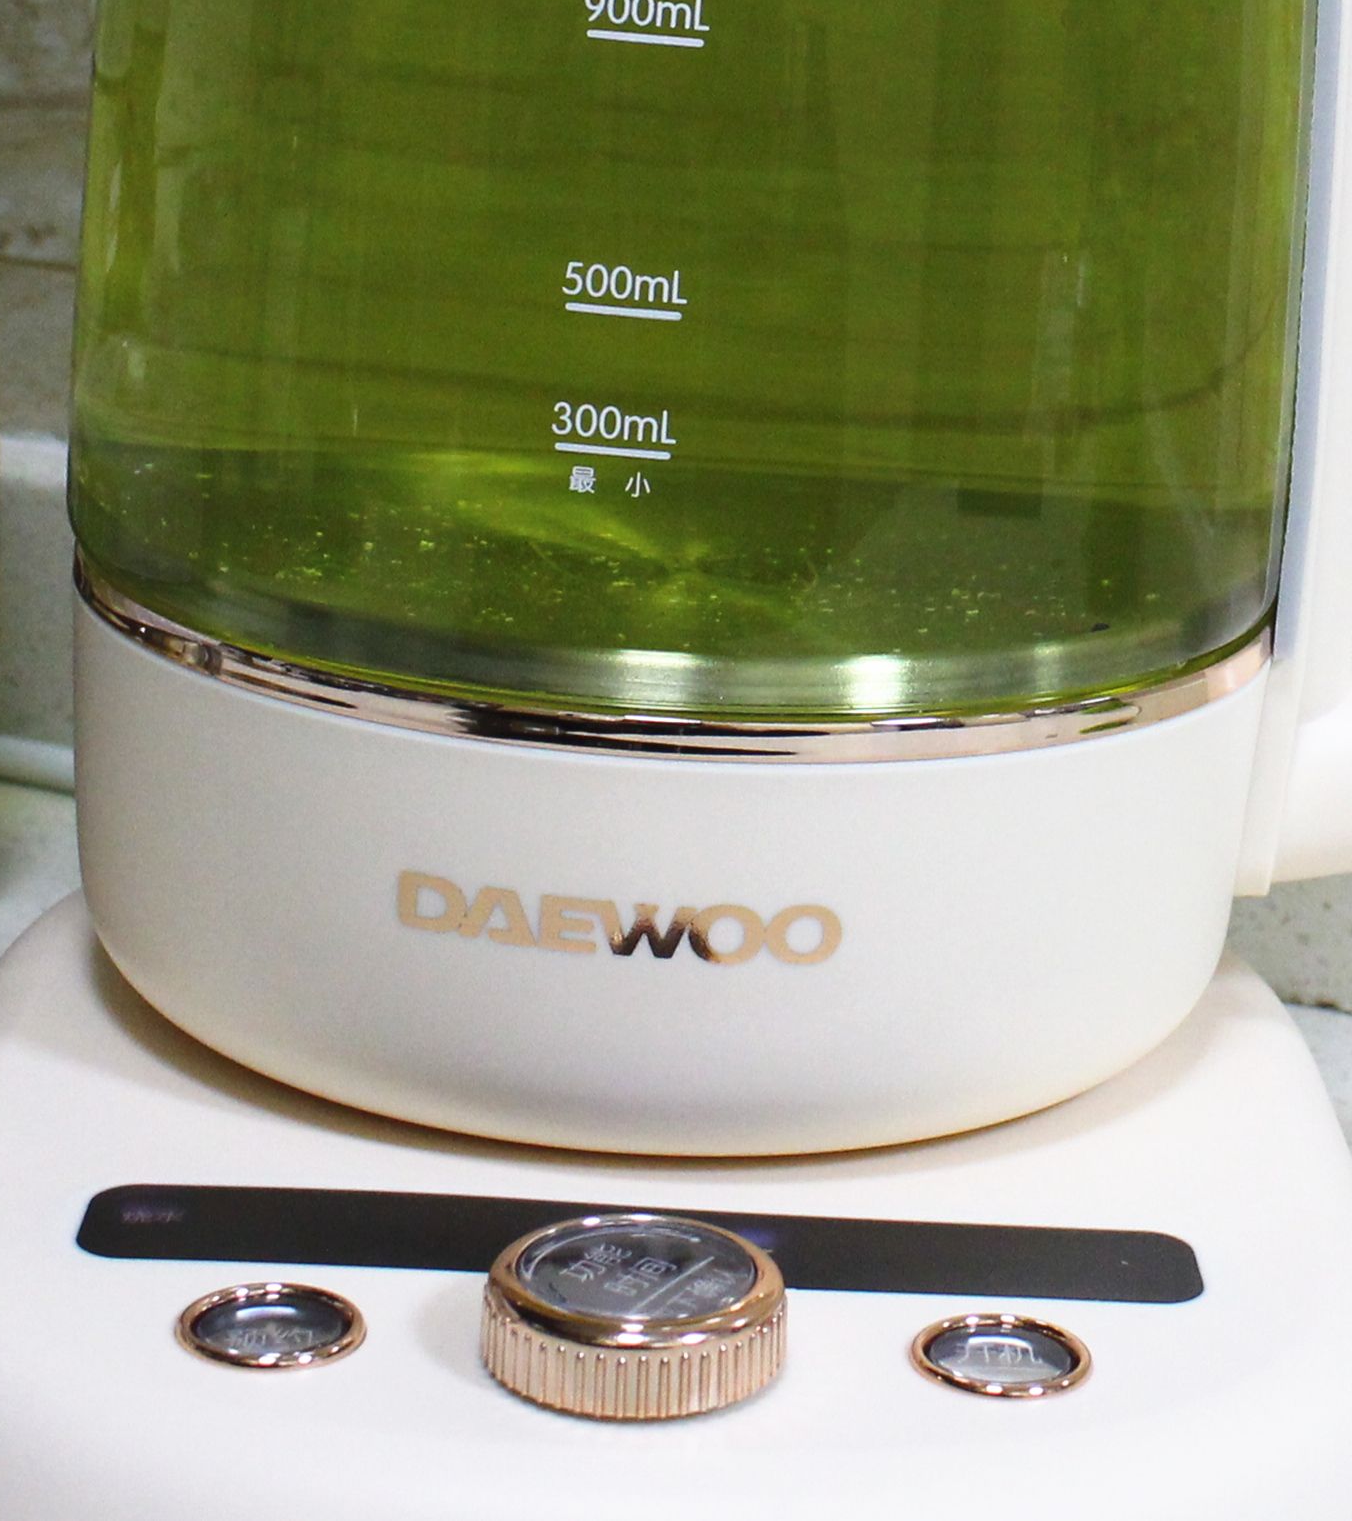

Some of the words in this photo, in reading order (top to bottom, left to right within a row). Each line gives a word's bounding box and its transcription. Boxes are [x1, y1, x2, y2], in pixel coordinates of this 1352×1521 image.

[562, 261, 688, 305] 500mL
[551, 401, 677, 445] 300mL
[395, 869, 844, 966] DAEWOO
